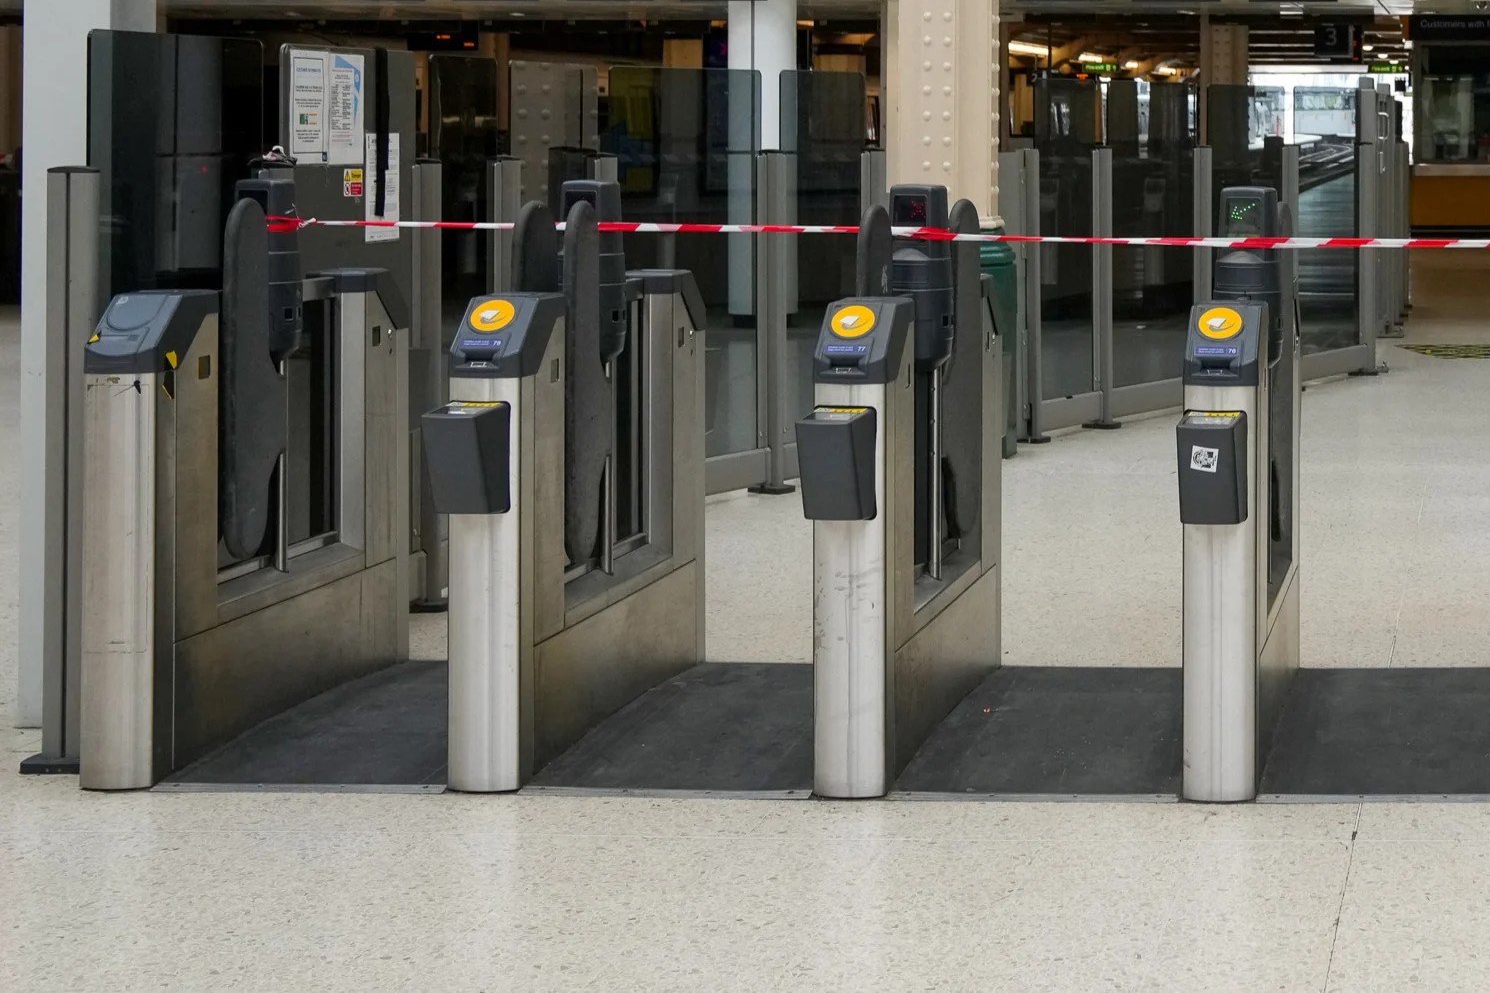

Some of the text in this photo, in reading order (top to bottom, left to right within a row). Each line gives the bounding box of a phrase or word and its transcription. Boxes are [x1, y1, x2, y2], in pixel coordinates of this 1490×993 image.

[1420, 19, 1466, 30] Customers
[1467, 19, 1485, 30] with
[1325, 29, 1338, 47] 3
